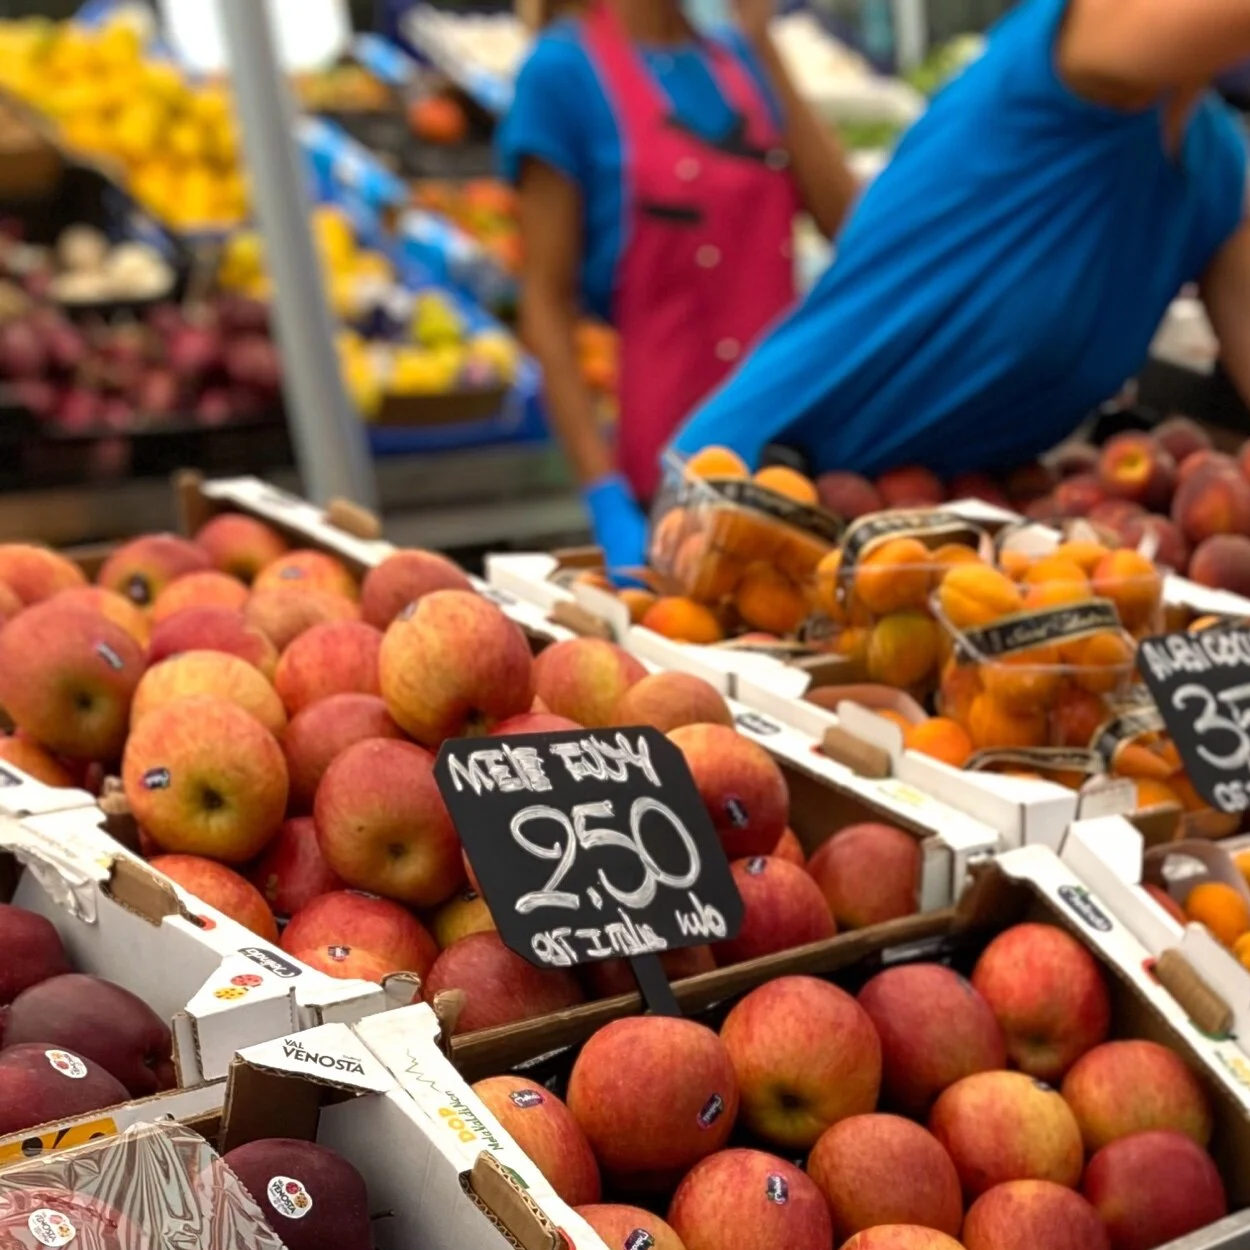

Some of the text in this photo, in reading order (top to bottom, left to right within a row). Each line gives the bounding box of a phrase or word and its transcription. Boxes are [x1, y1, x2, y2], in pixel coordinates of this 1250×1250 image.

[509, 796, 702, 913] 2,50
[282, 1045, 366, 1076] VENOSTA
[284, 1038, 305, 1050] VAL
[437, 1106, 477, 1144] DOP
